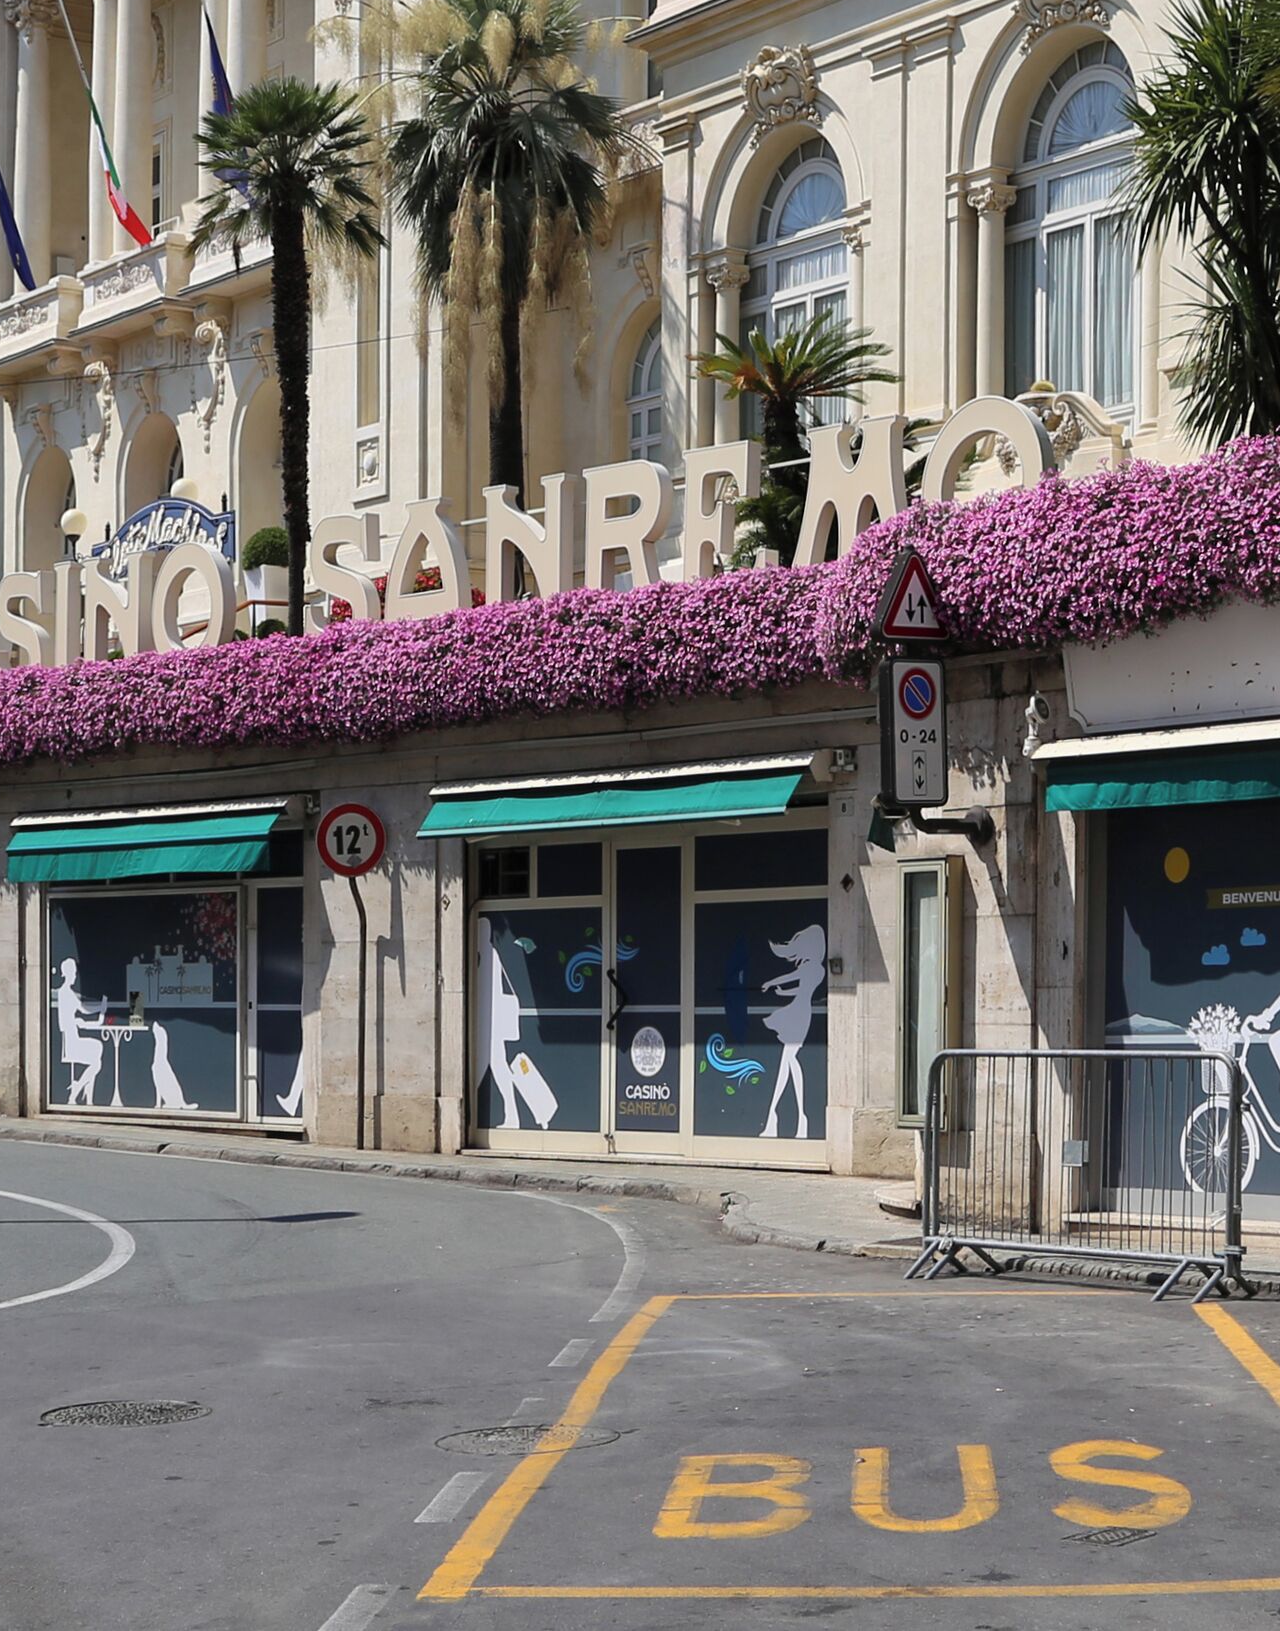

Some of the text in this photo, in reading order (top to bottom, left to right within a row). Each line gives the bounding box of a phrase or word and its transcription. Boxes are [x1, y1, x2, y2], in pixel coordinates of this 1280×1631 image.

[302, 395, 1054, 634] SANREMO
[619, 1101, 677, 1116] SANREMO
[652, 1439, 1193, 1539] BUS
